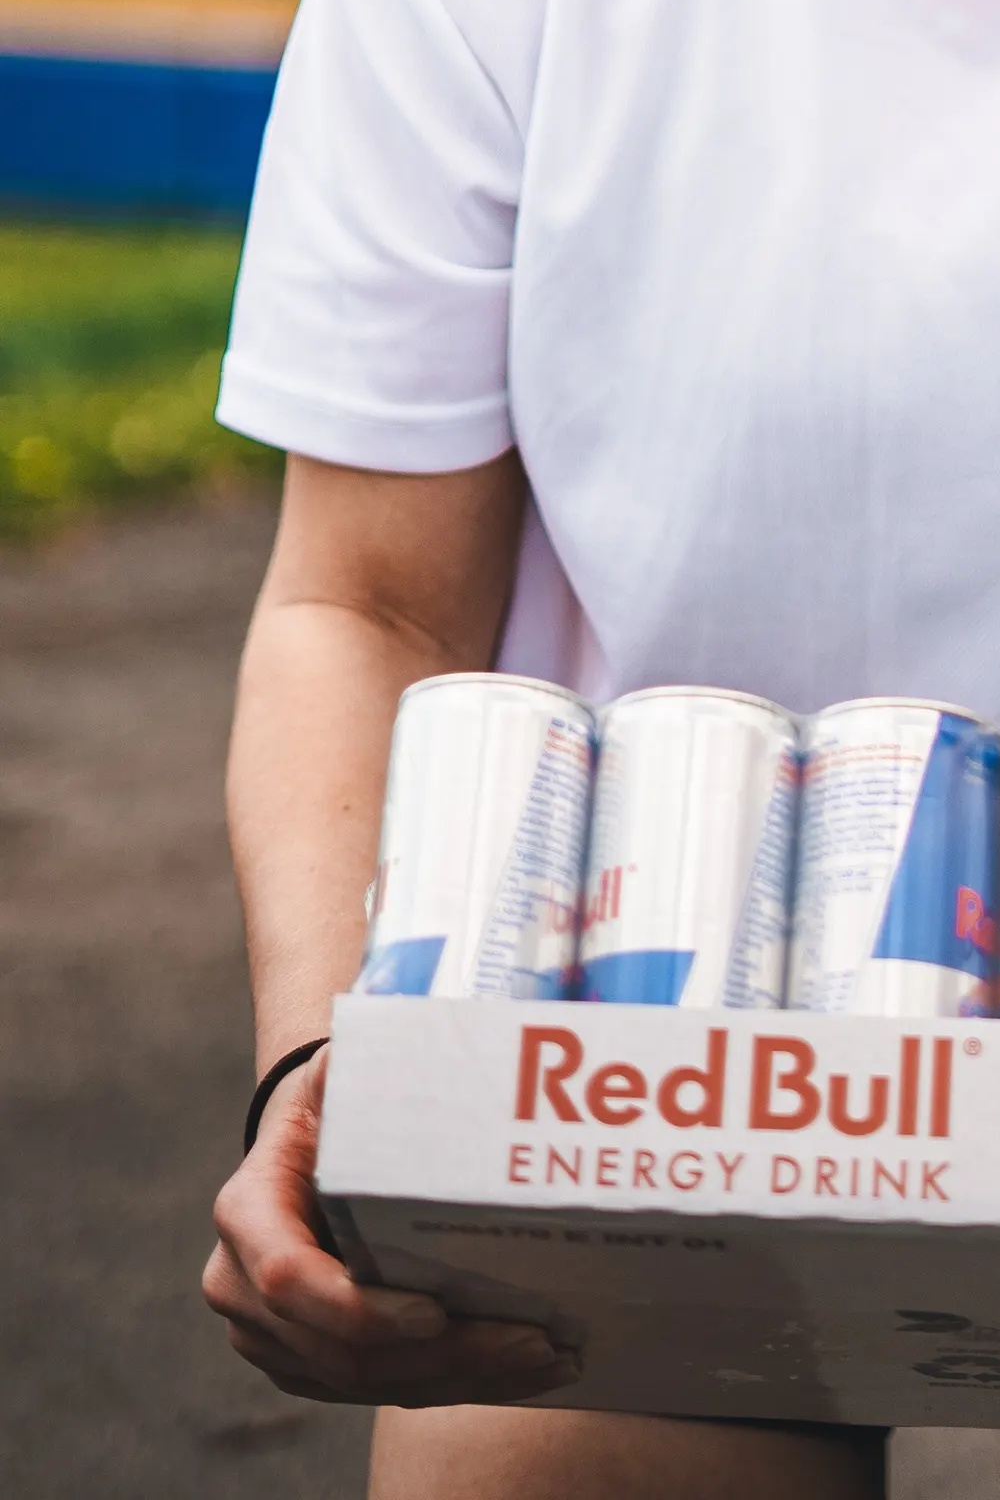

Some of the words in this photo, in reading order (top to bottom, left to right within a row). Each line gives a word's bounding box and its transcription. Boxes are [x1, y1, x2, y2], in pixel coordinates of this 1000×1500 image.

[513, 1024, 730, 1129] Red
[506, 1143, 746, 1194] ENERGY
[768, 1153, 953, 1203] DRINK
